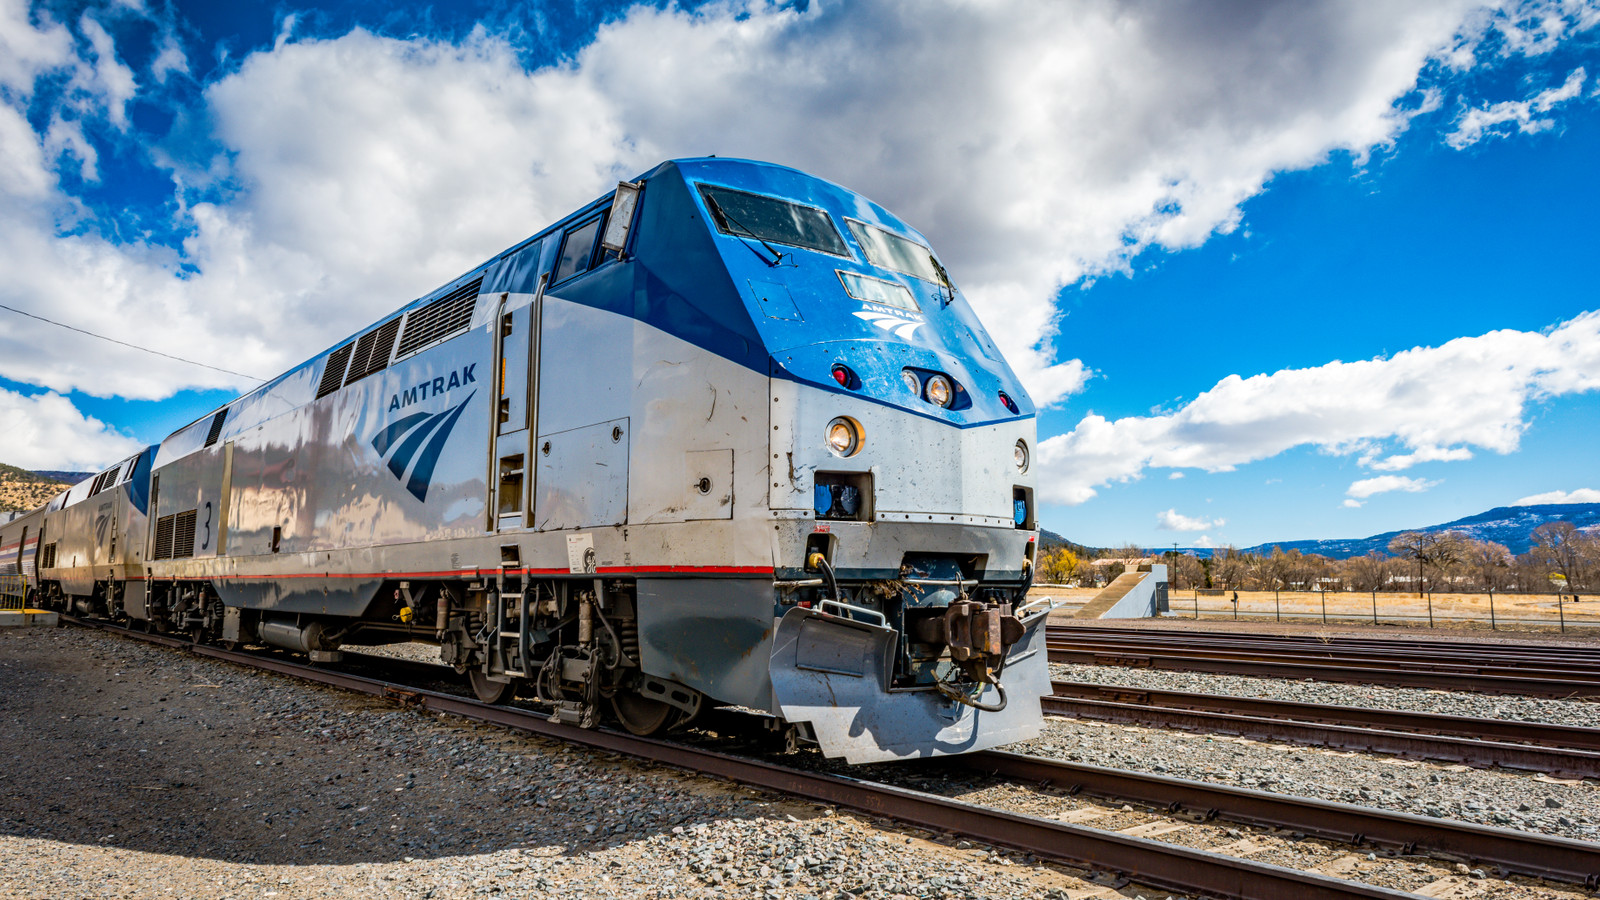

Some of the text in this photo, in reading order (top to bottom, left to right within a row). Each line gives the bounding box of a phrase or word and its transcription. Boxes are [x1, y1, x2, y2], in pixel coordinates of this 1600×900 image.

[862, 303, 924, 321] AMTRAK
[388, 363, 477, 412] AMTRAK
[202, 501, 212, 550] 3
[623, 529, 628, 542] F
